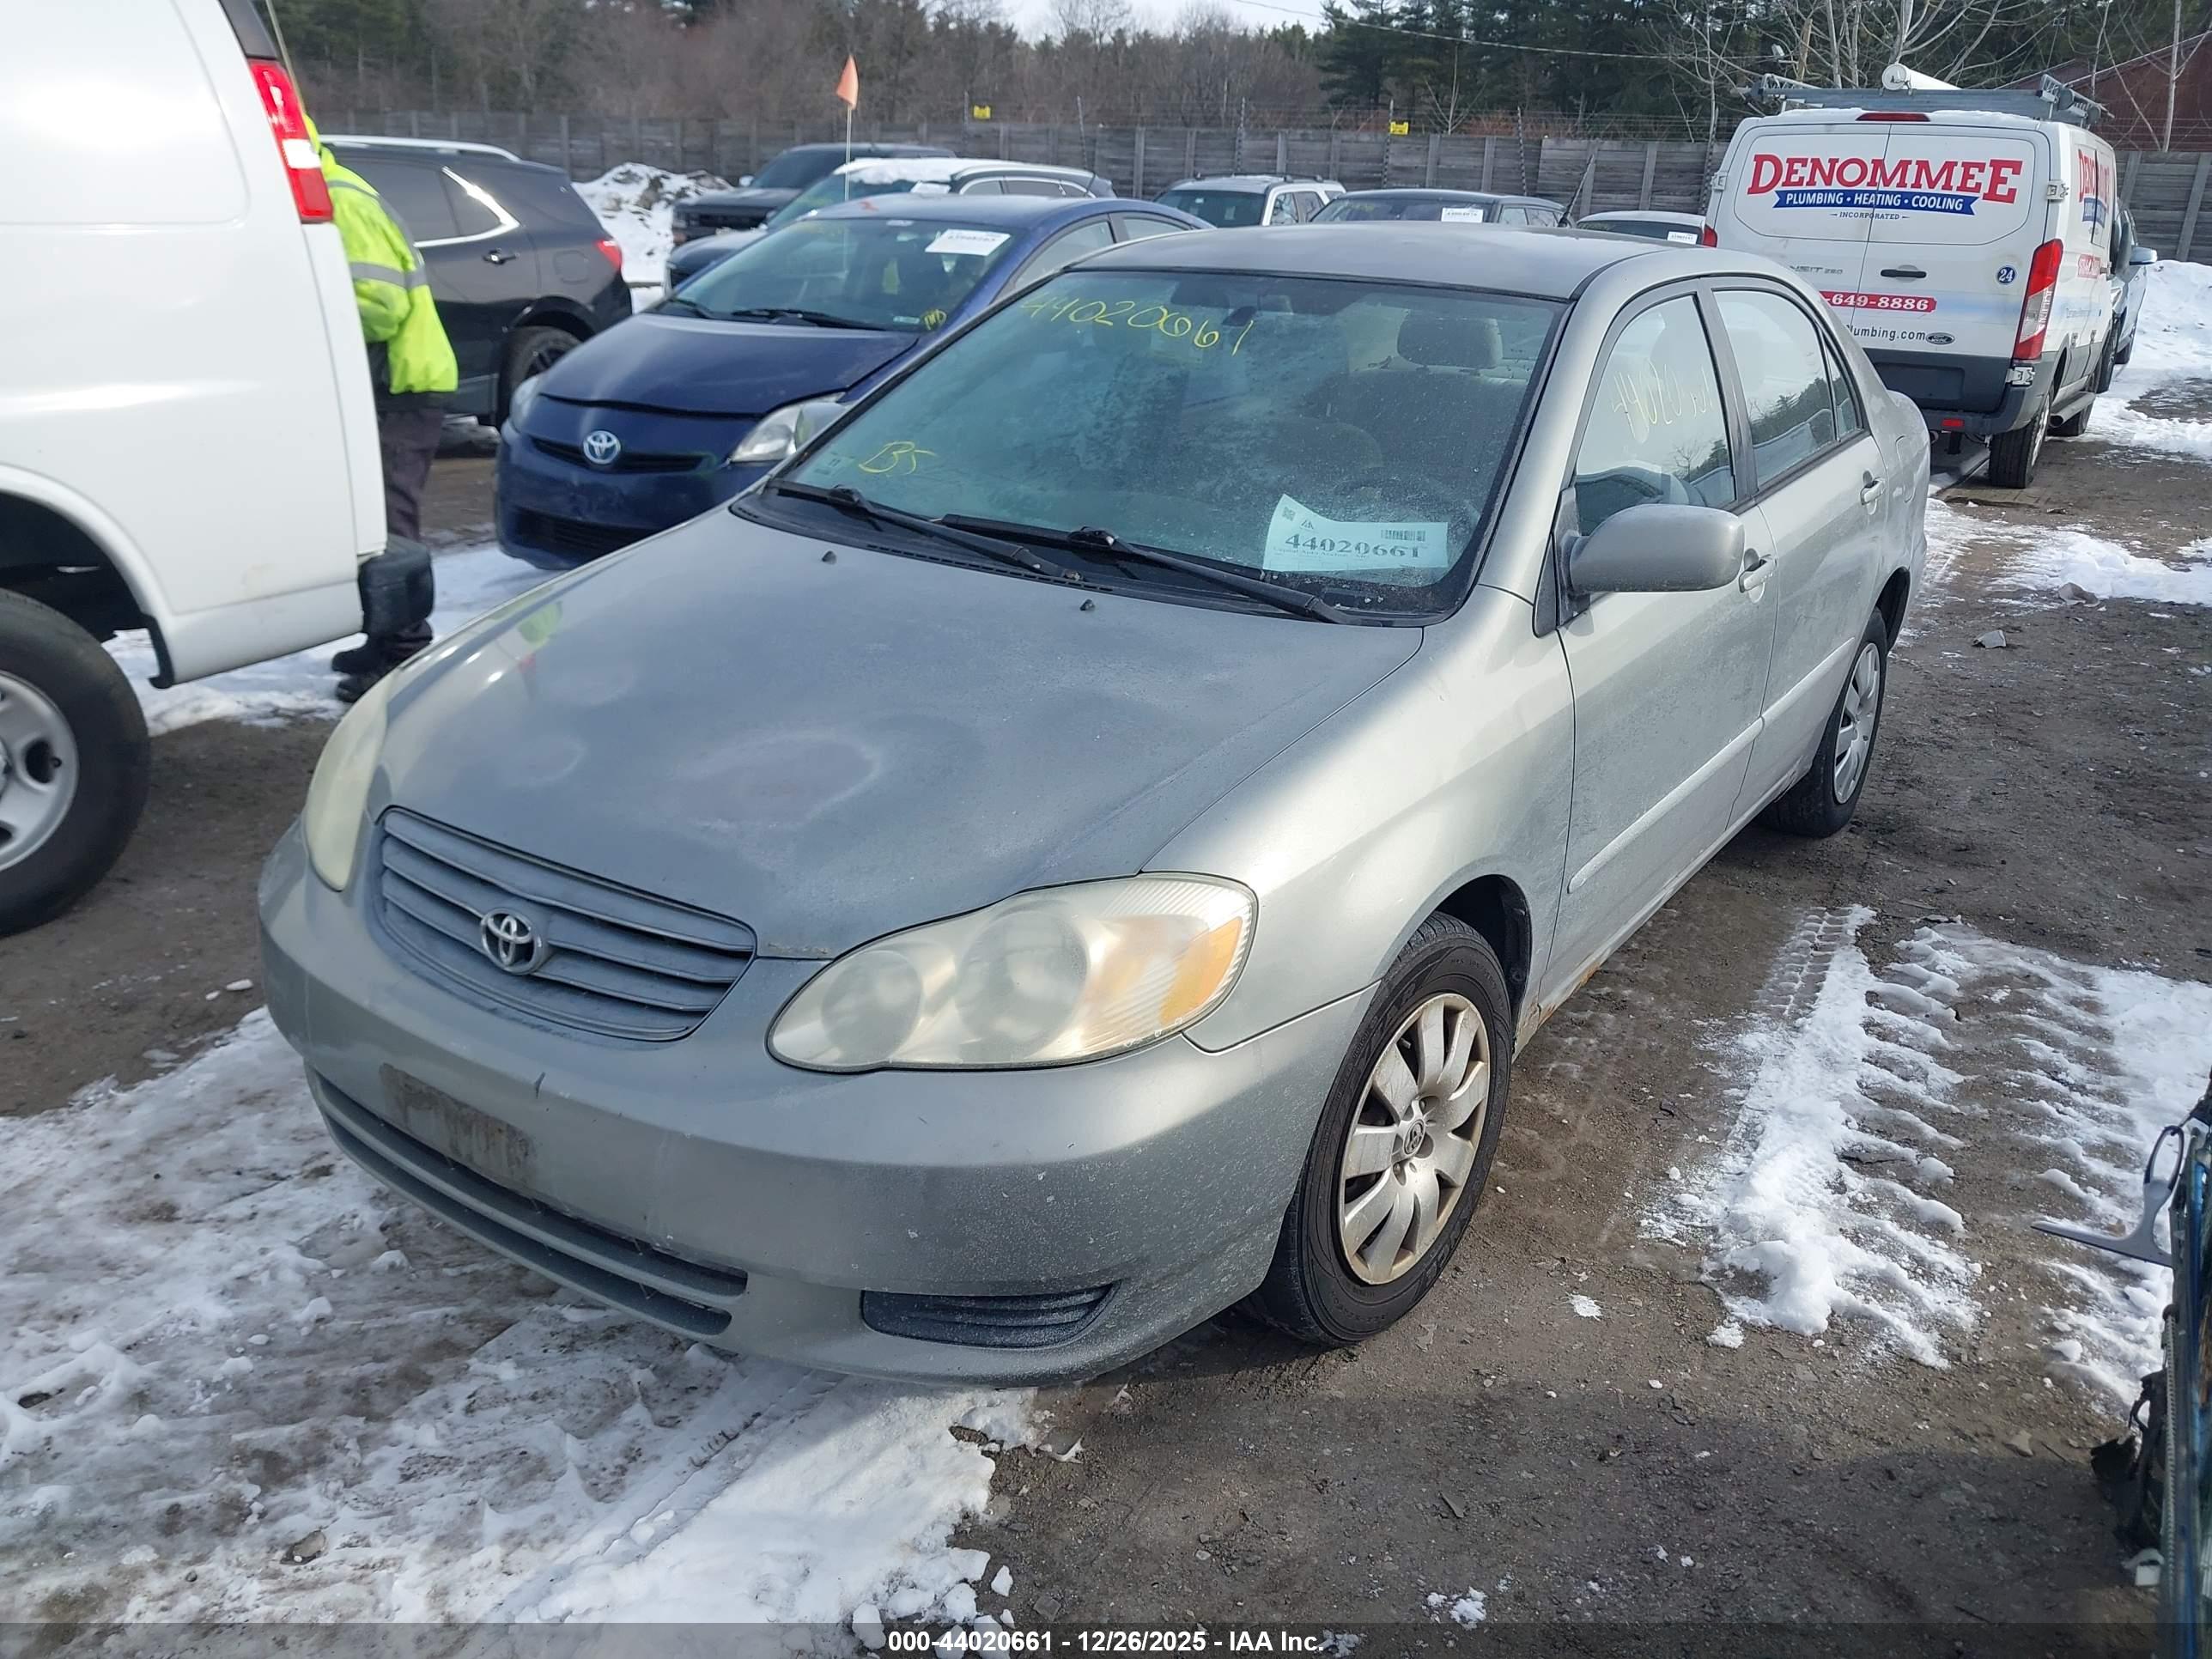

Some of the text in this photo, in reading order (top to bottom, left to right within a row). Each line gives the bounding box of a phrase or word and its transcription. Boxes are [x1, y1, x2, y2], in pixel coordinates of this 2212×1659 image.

[1746, 153, 2024, 205] DENOMMEE
[1785, 192, 1965, 211] PLUMBING HEATING COOLING
[1838, 211, 1901, 221] INCORPORATED
[1998, 268, 2014, 283] 24
[1826, 294, 1930, 312] -649-8886
[1021, 297, 1255, 357] 44020661
[1846, 324, 1926, 341] lumbing.com
[1285, 533, 1420, 558] 44020661
